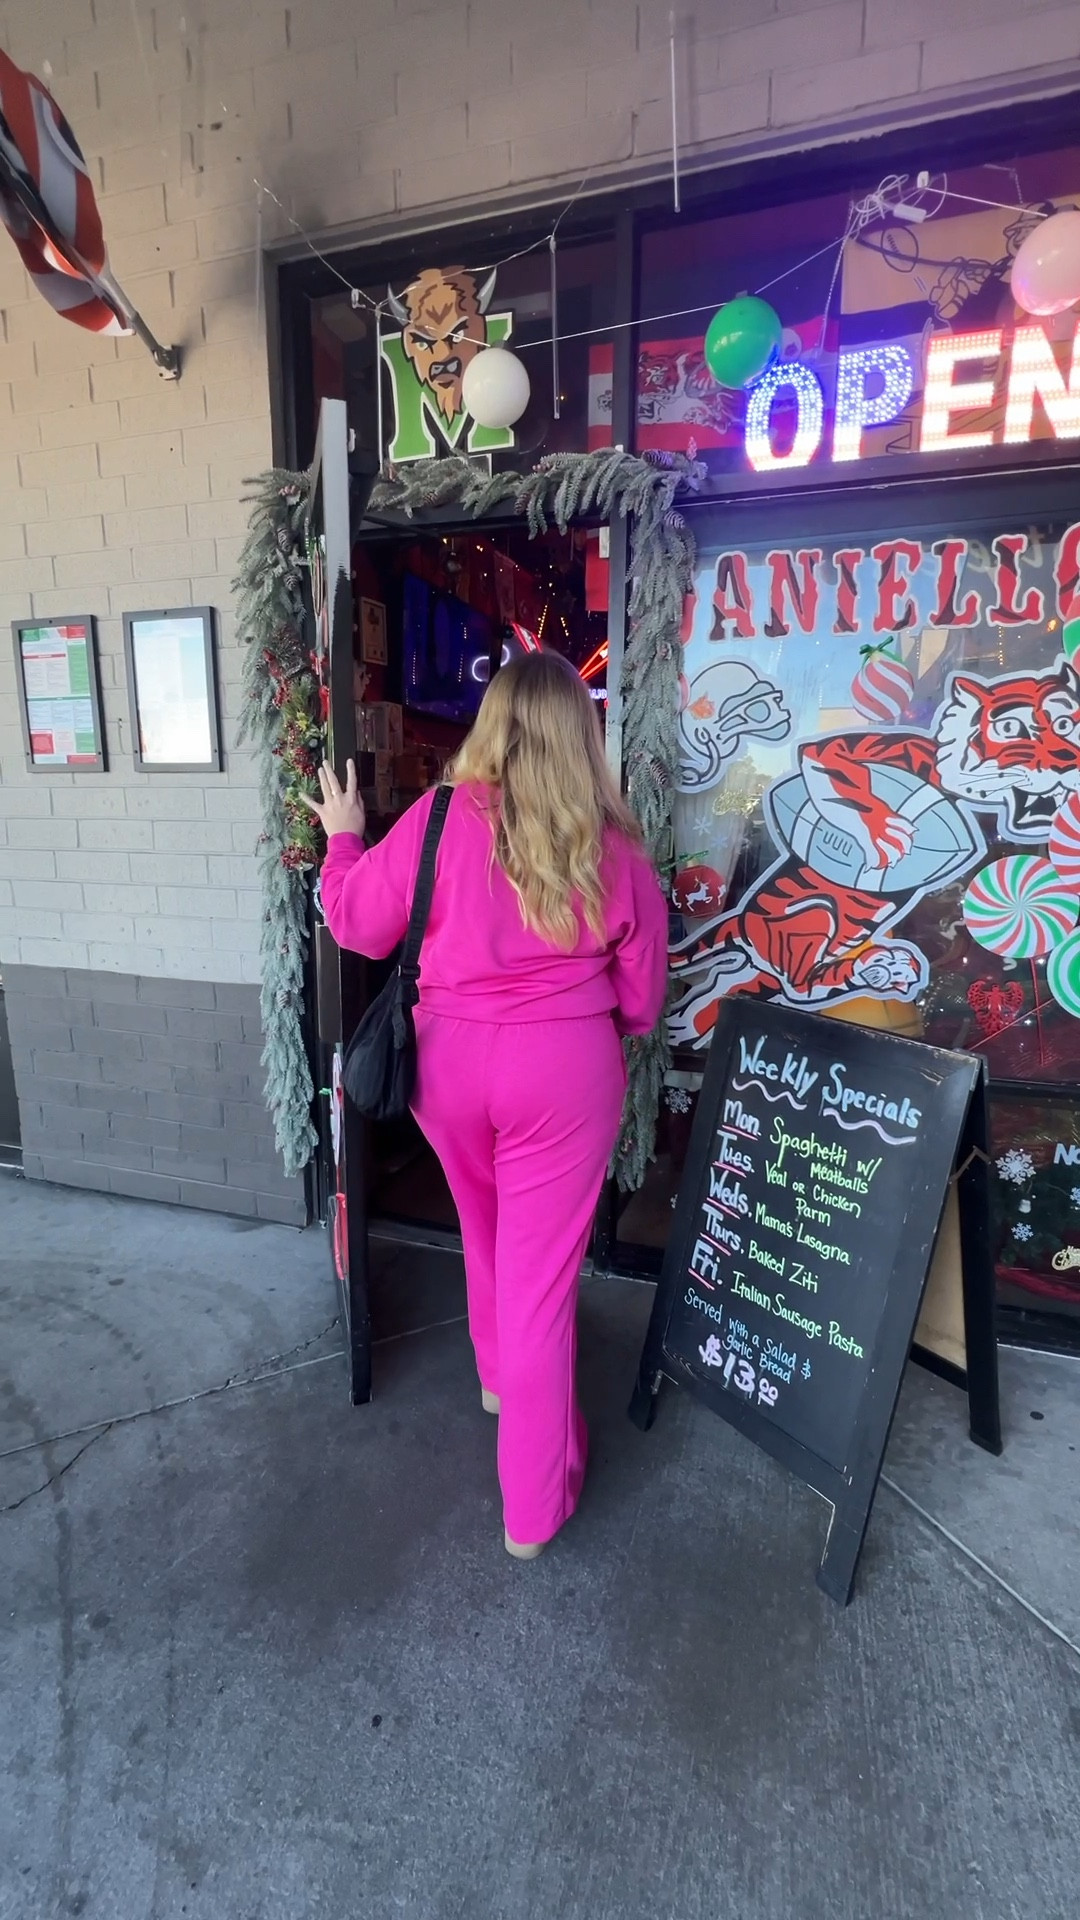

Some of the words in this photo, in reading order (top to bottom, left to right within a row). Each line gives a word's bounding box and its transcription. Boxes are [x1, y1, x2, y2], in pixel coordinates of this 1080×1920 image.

[745, 323, 1080, 472] OPEN
[680, 521, 1080, 648] ANIELL
[739, 1034, 819, 1099] Weekly
[821, 1062, 922, 1129] Specials
[716, 1129, 755, 1173] Tues.
[765, 1160, 787, 1188] Veal
[813, 1184, 862, 1219] Chicken
[769, 1116, 848, 1168] Spaghetti
[702, 1202, 745, 1254] Thurs.
[748, 1239, 785, 1277] Baked
[788, 1262, 819, 1294] Ziti
[755, 1202, 793, 1238] Mama's
[796, 1223, 851, 1266] Lasagna
[795, 1197, 831, 1227] Parm
[684, 1287, 723, 1325] Served
[751, 1334, 760, 1348] a
[763, 1338, 797, 1371] Salad
[691, 1238, 723, 1286] Fri.
[730, 1270, 772, 1312] Italian
[771, 1293, 823, 1339] Sausage
[828, 1320, 864, 1359] Pasta
[758, 1352, 792, 1385] Bread
